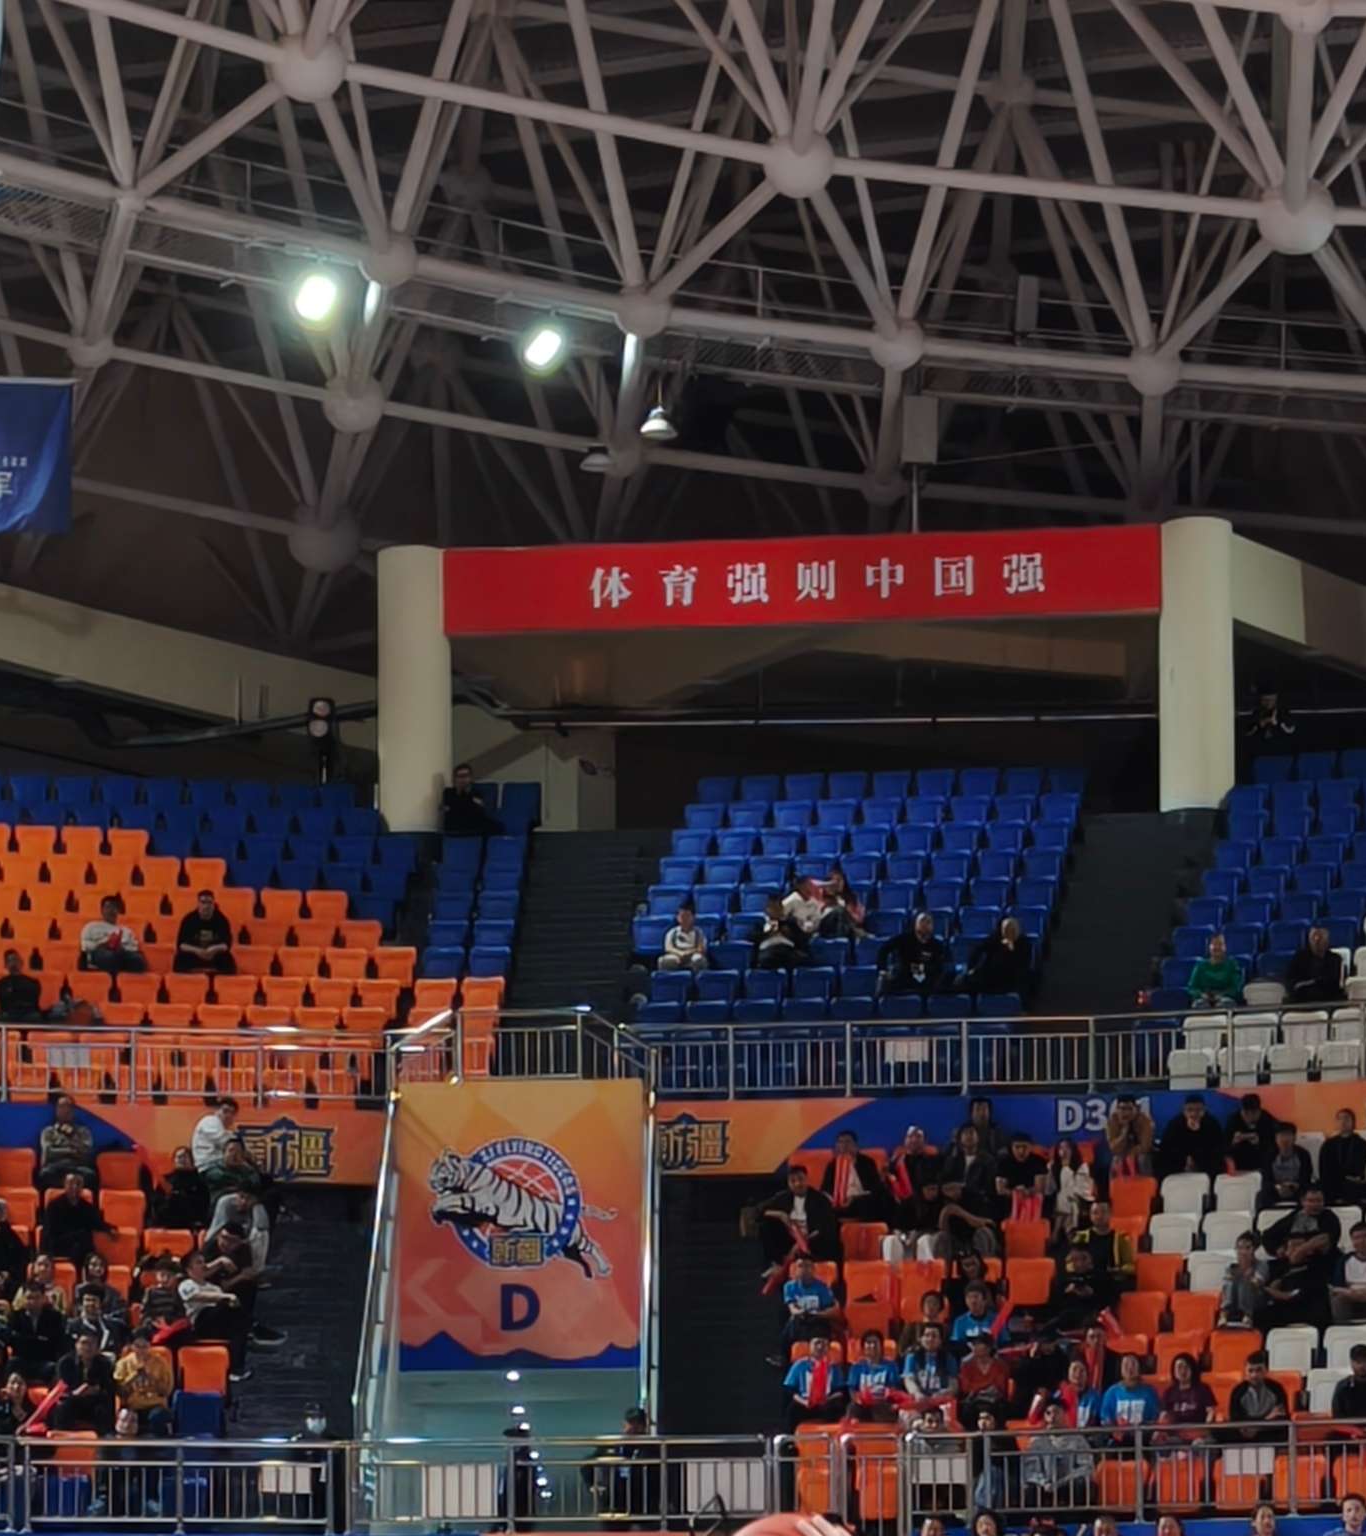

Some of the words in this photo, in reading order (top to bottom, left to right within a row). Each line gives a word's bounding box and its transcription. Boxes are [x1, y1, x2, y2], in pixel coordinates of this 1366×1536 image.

[589, 552, 1047, 610] 体育强则中国强
[499, 1283, 540, 1332] D
